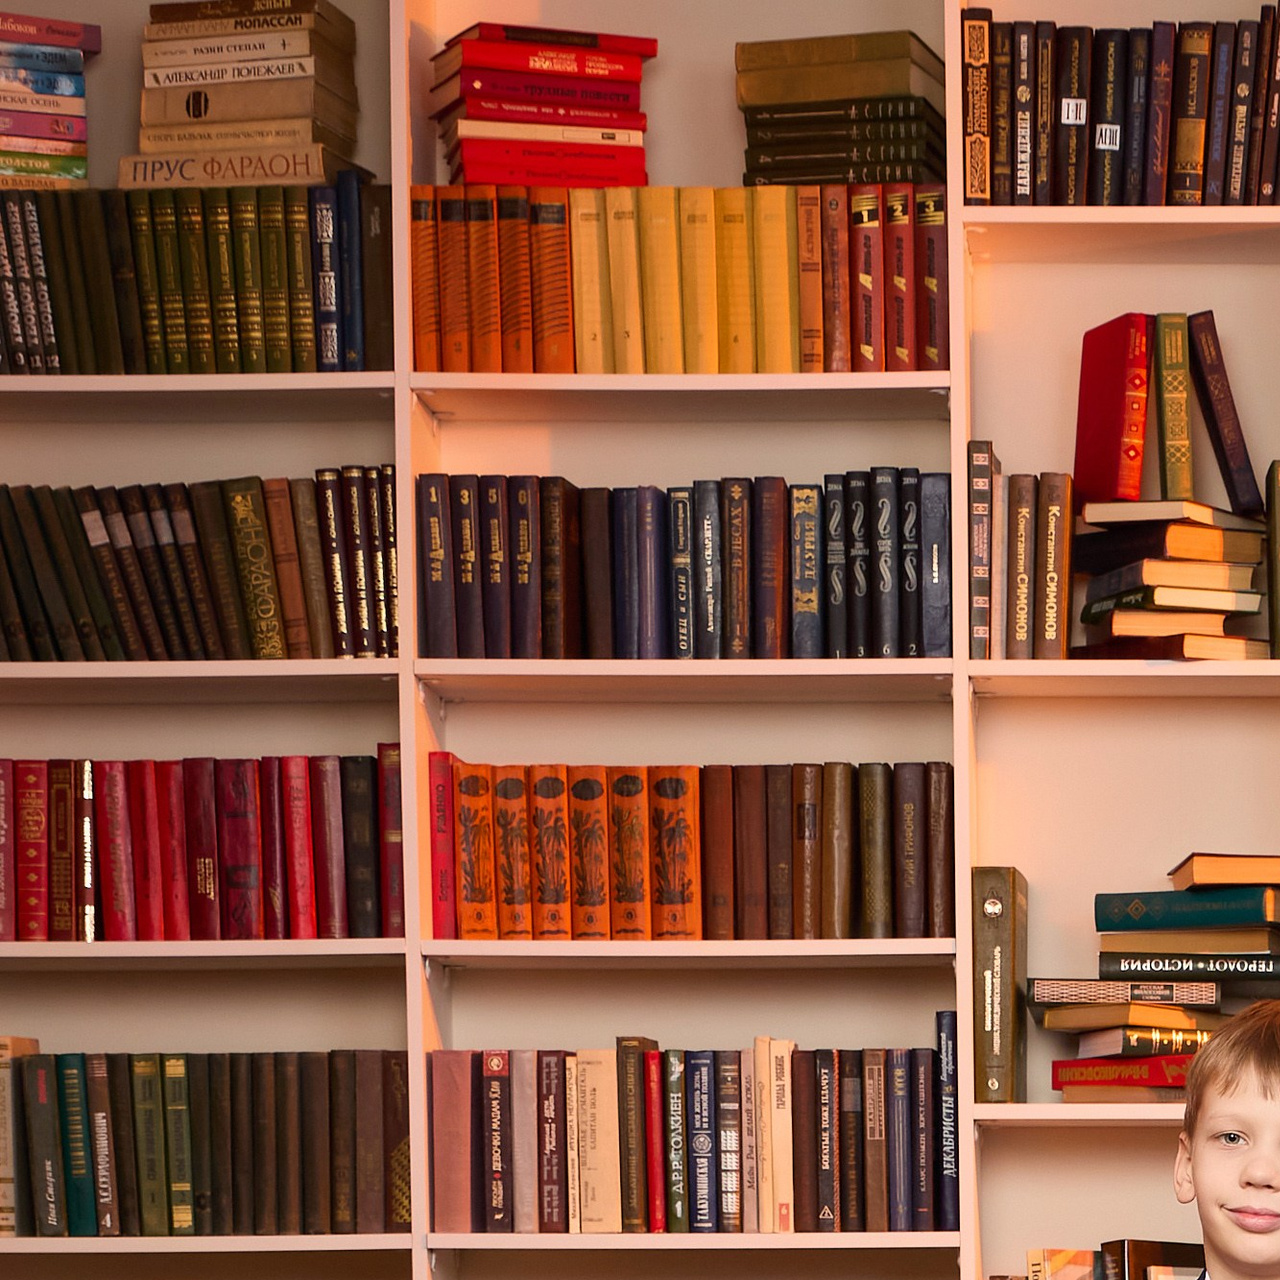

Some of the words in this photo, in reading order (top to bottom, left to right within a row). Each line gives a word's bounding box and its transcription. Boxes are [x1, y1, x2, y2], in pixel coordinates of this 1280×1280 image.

[234, 14, 303, 30] МОПАССАН
[193, 45, 224, 56] РАЗИН
[226, 42, 266, 54] СТЕПАН
[163, 68, 227, 84] АЛЕКСАНДР
[232, 62, 296, 80] ПОЛЕЖАЕВ
[133, 158, 196, 182] ПРУС
[203, 153, 311, 179] ФАРАОН
[1016, 111, 1030, 195] НАВАЖДЕНИЕ
[731, 507, 742, 555] ЛЕСАХ
[1016, 507, 1029, 571] Константин
[1047, 505, 1060, 571] Константин
[732, 558, 741, 568] В
[804, 521, 815, 579] ДАУРИЯ
[677, 575, 686, 601] СЫН
[1016, 573, 1029, 641] СИМОНОВ
[1045, 572, 1058, 640] СИМОНОВ
[678, 618, 687, 650] ОТЕЦ
[1120, 958, 1194, 973] ИСТОРИЯ
[1205, 956, 1274, 972] ГЕРОДОТ
[820, 1067, 829, 1102] ПЛАЧУТ
[671, 1092, 682, 1156] ТОЛКИЕН
[821, 1104, 829, 1128] ТОЖЕ
[821, 1133, 830, 1170] БОГАТЫЕ
[942, 1096, 955, 1177] ДЕКАБРИСТЫ
